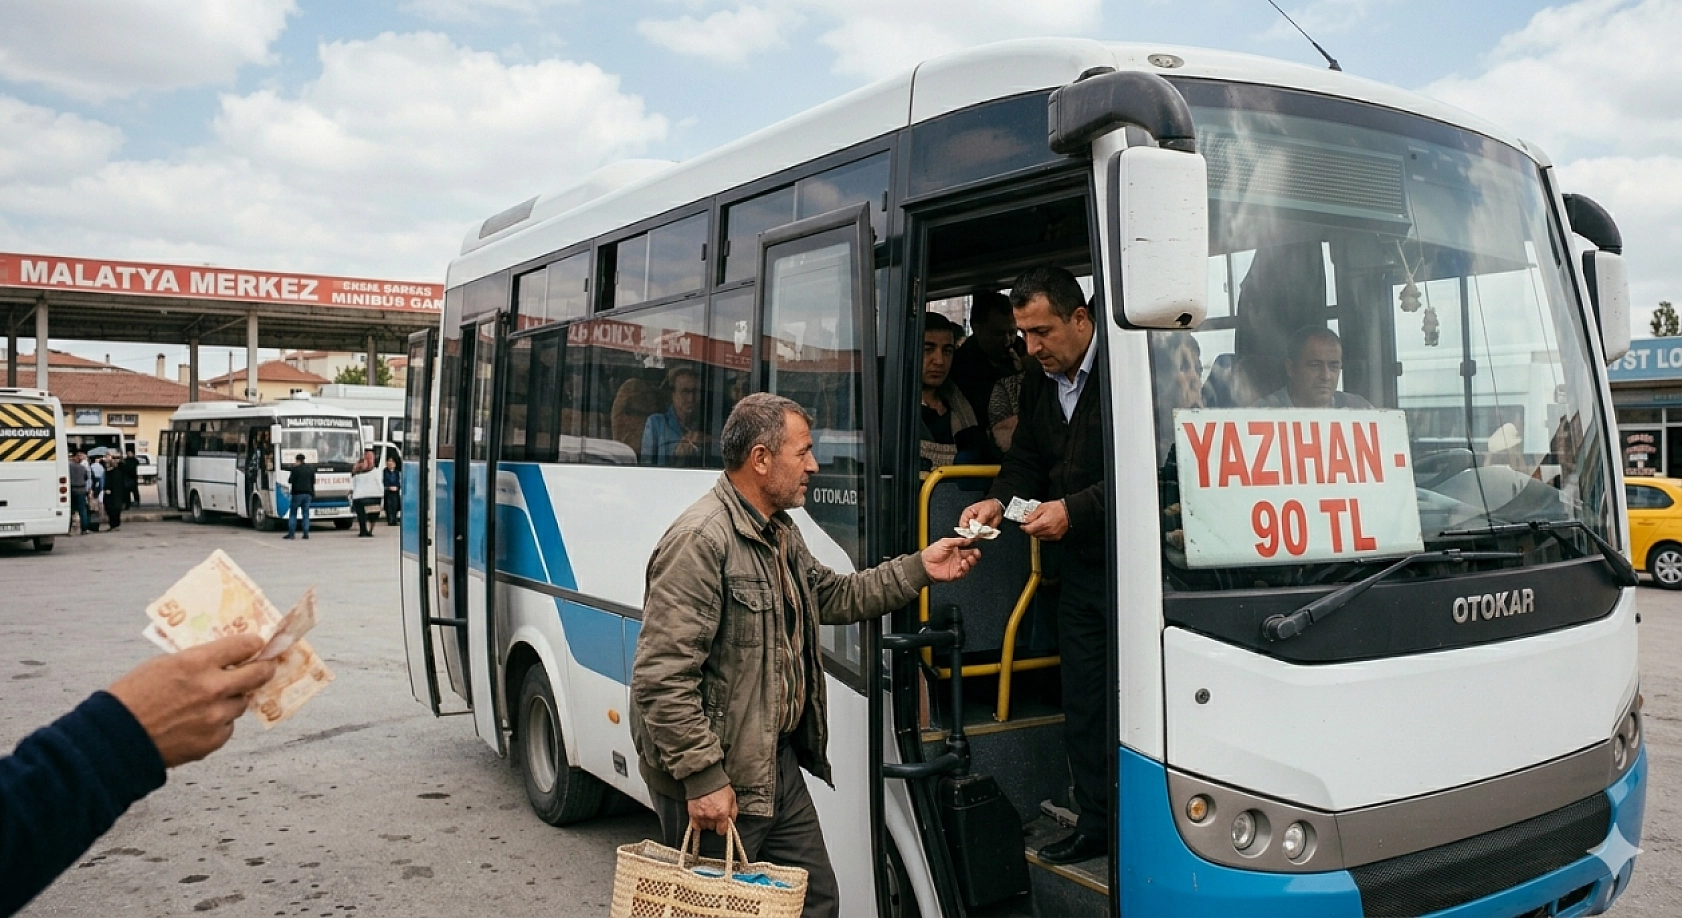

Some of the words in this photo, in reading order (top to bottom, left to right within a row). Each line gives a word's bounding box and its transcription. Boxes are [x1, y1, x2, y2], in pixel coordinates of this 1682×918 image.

[20, 259, 180, 293] MALATYA
[189, 271, 319, 301] MERKEZ
[331, 292, 405, 307] MINIBUS
[1182, 420, 1385, 488] YAZIHAN
[1251, 499, 1308, 558] 90
[1319, 497, 1377, 554] TL
[158, 598, 187, 627] 50
[1451, 587, 1535, 625] OTOKAR
